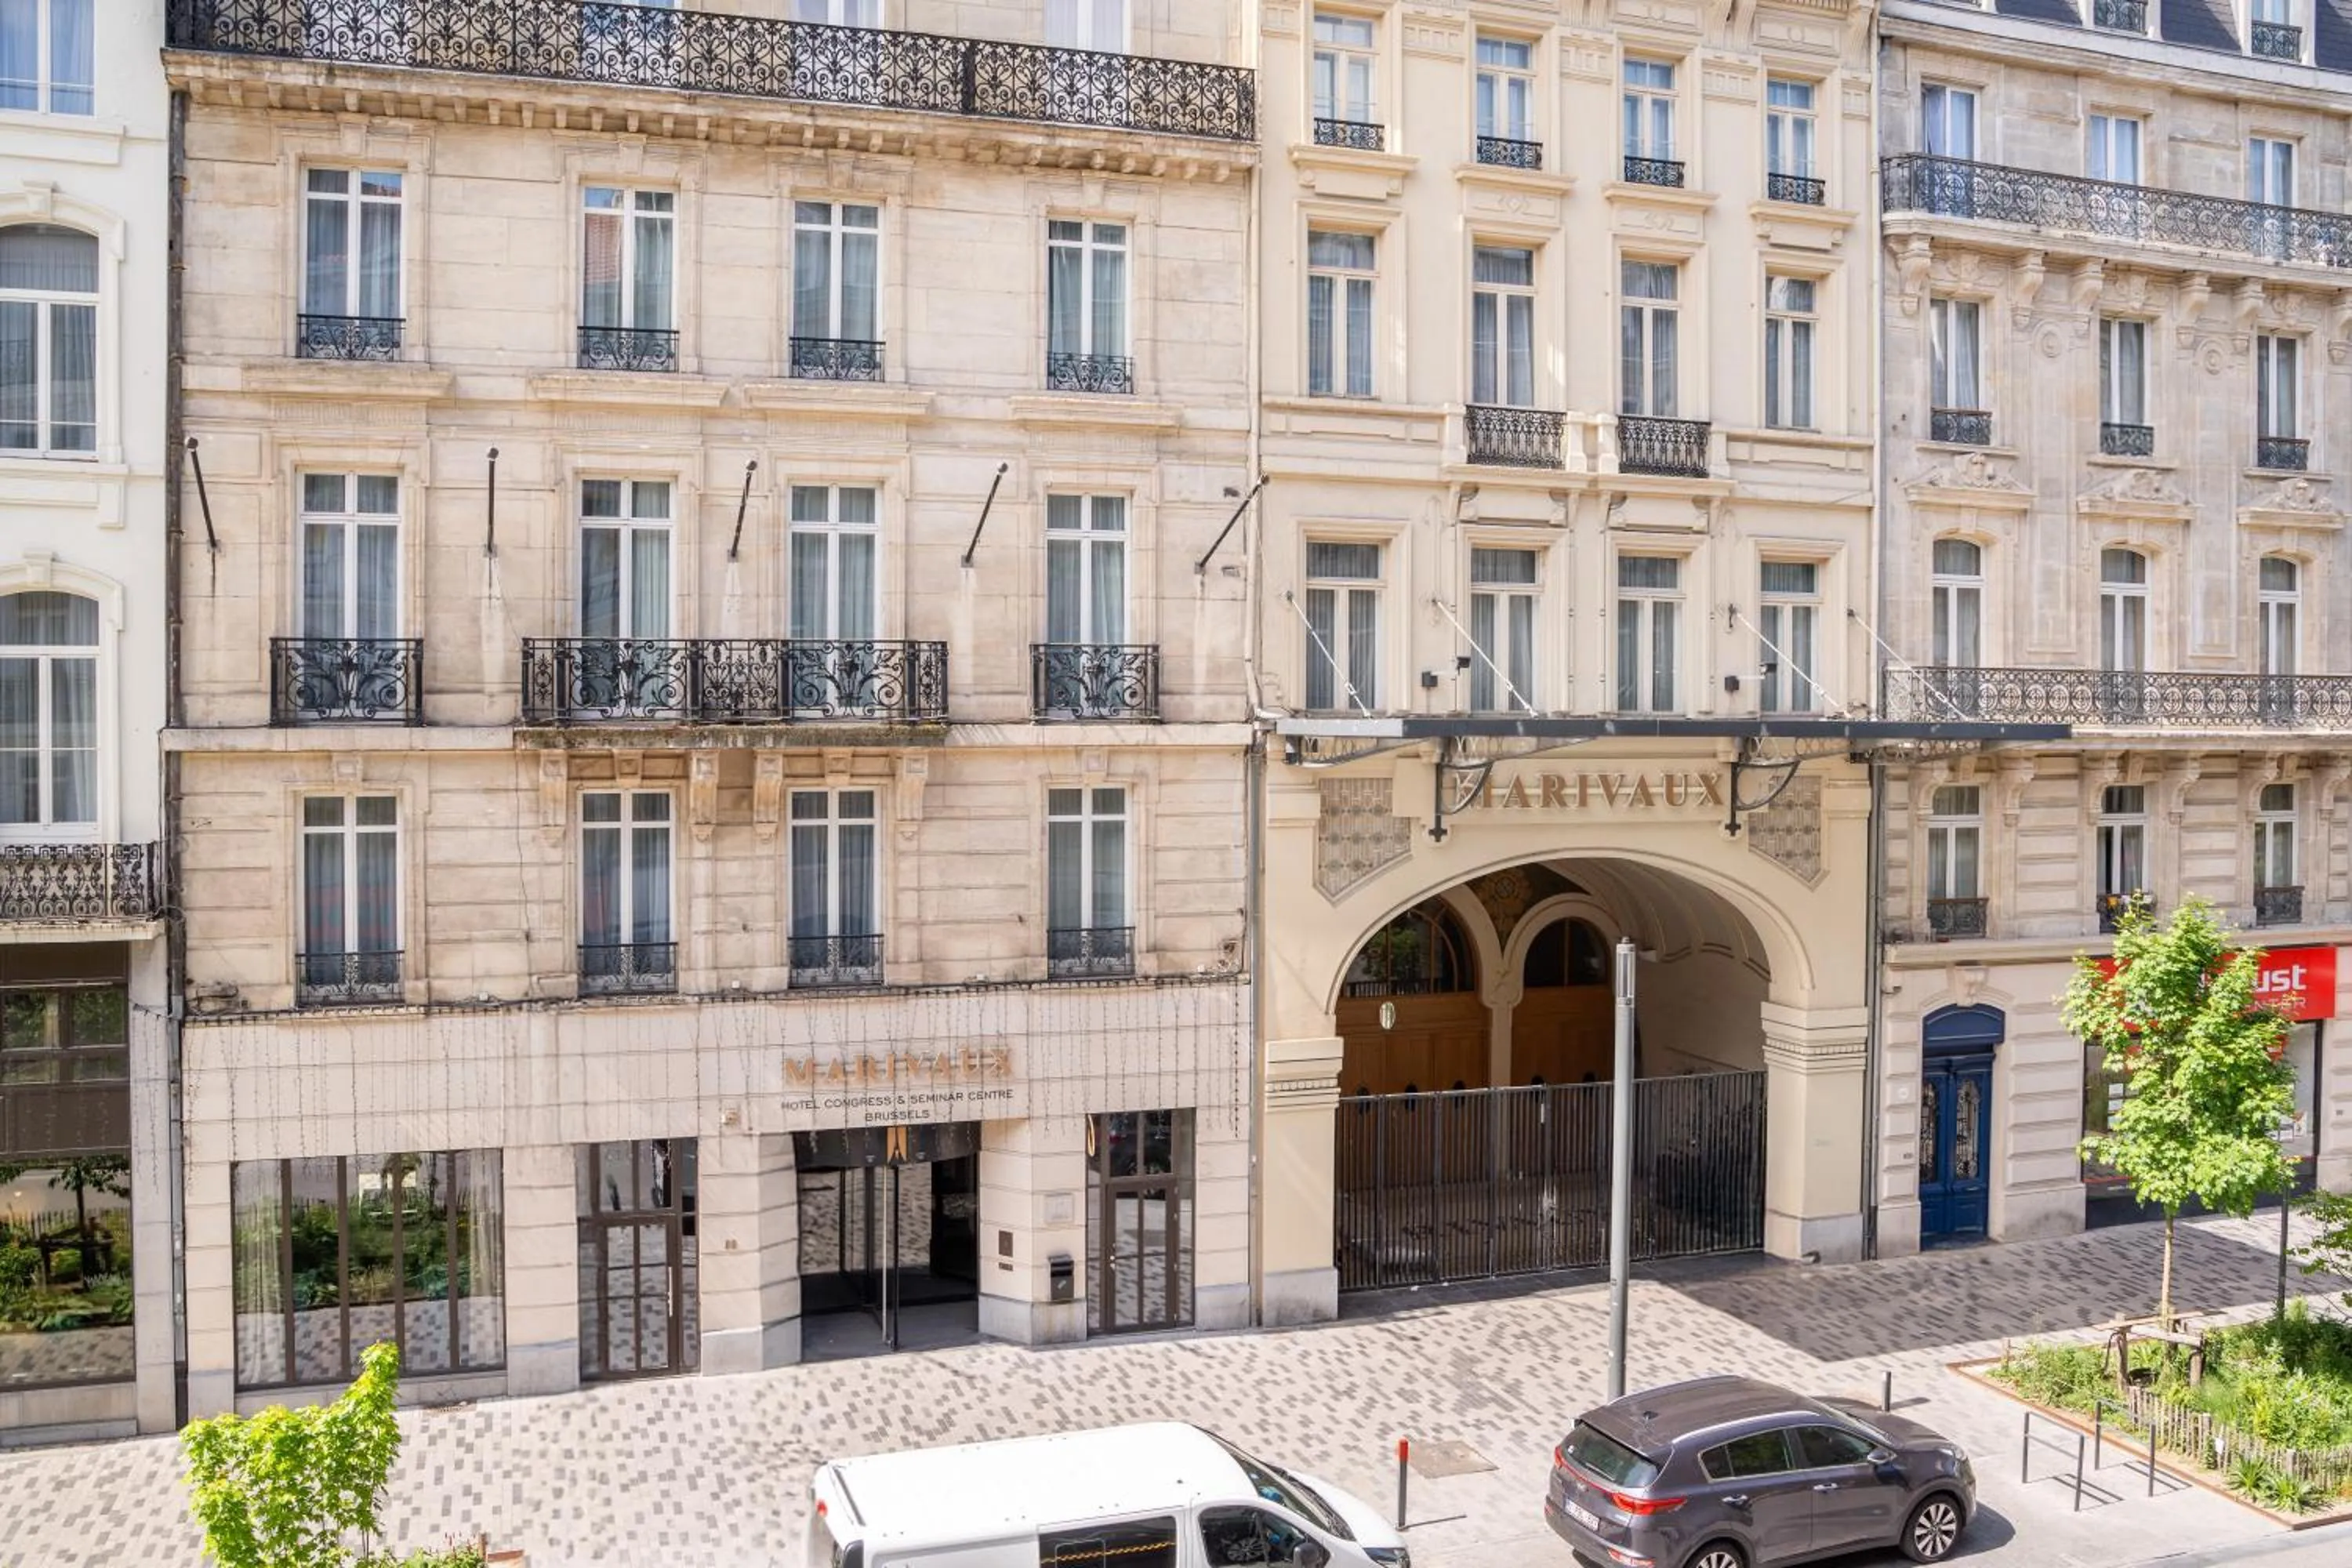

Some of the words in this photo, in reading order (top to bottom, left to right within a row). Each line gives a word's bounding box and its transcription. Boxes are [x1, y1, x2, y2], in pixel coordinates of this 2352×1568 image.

[2252, 965, 2307, 993] ust
[784, 1047, 1014, 1084] MARIVAUX
[781, 1099, 820, 1109] HOTEL
[824, 1096, 891, 1108] CONGRESS
[896, 1095, 906, 1105] &
[909, 1092, 964, 1104] SEMINAR
[968, 1089, 1014, 1101] CENTRE
[865, 1109, 930, 1122] BRUSSELS
